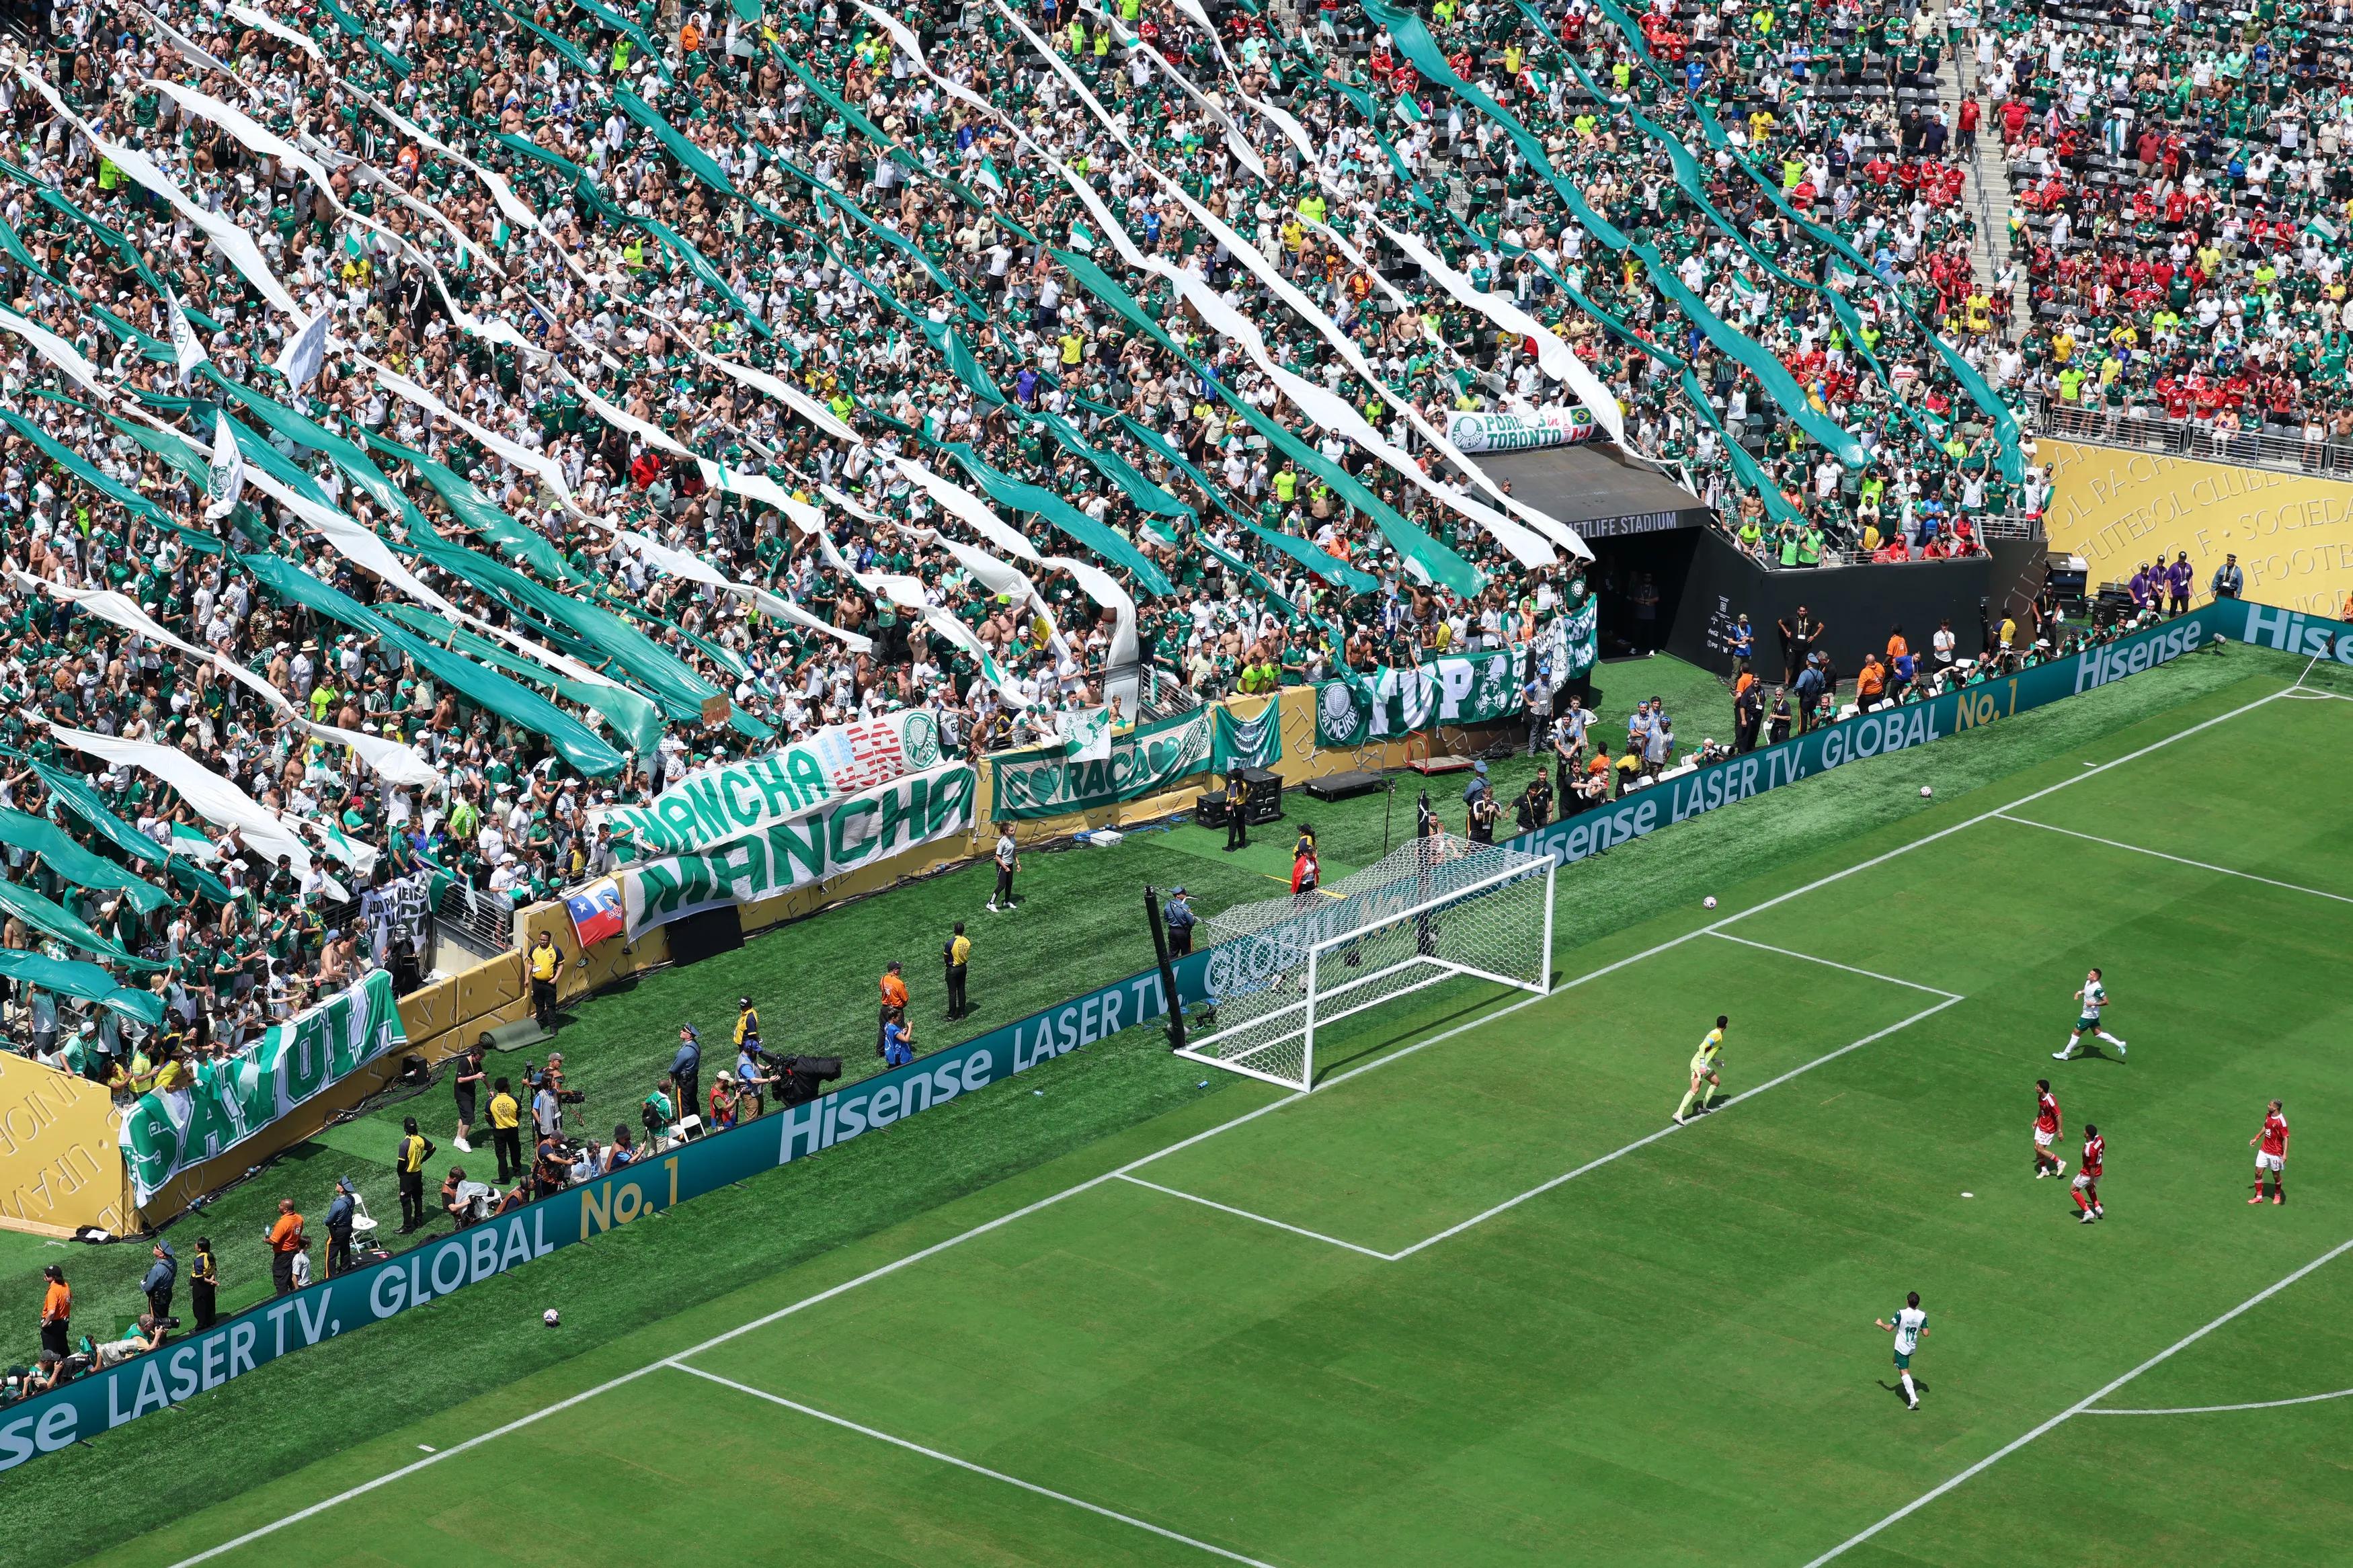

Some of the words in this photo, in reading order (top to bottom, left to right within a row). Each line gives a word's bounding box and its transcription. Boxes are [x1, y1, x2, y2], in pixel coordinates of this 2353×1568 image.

[1452, 429, 1484, 449] PALMEIRAS
[1487, 429, 1561, 449] TORONTO
[1548, 417, 1560, 427] in
[1621, 511, 1677, 534] STADIUM
[2075, 491, 2192, 570] FUTEBOL
[2075, 620, 2201, 694] Hisense
[1821, 704, 1939, 770] GLOBAL
[1955, 691, 1999, 732] No.
[2008, 679, 2017, 716] 1
[616, 749, 830, 864] MANCHA
[639, 768, 973, 927] MANCHA
[1502, 798, 1656, 889] Hisense
[1672, 762, 1757, 825] LASER
[1765, 741, 1806, 790] TV,
[779, 1050, 992, 1165] Hisense
[1013, 989, 1122, 1075] LASER
[370, 1208, 554, 1317] GLOBAL
[580, 1182, 653, 1240] No.
[664, 1157, 678, 1205] 1
[109, 1321, 256, 1428] LASER
[267, 1287, 340, 1356] TV,
